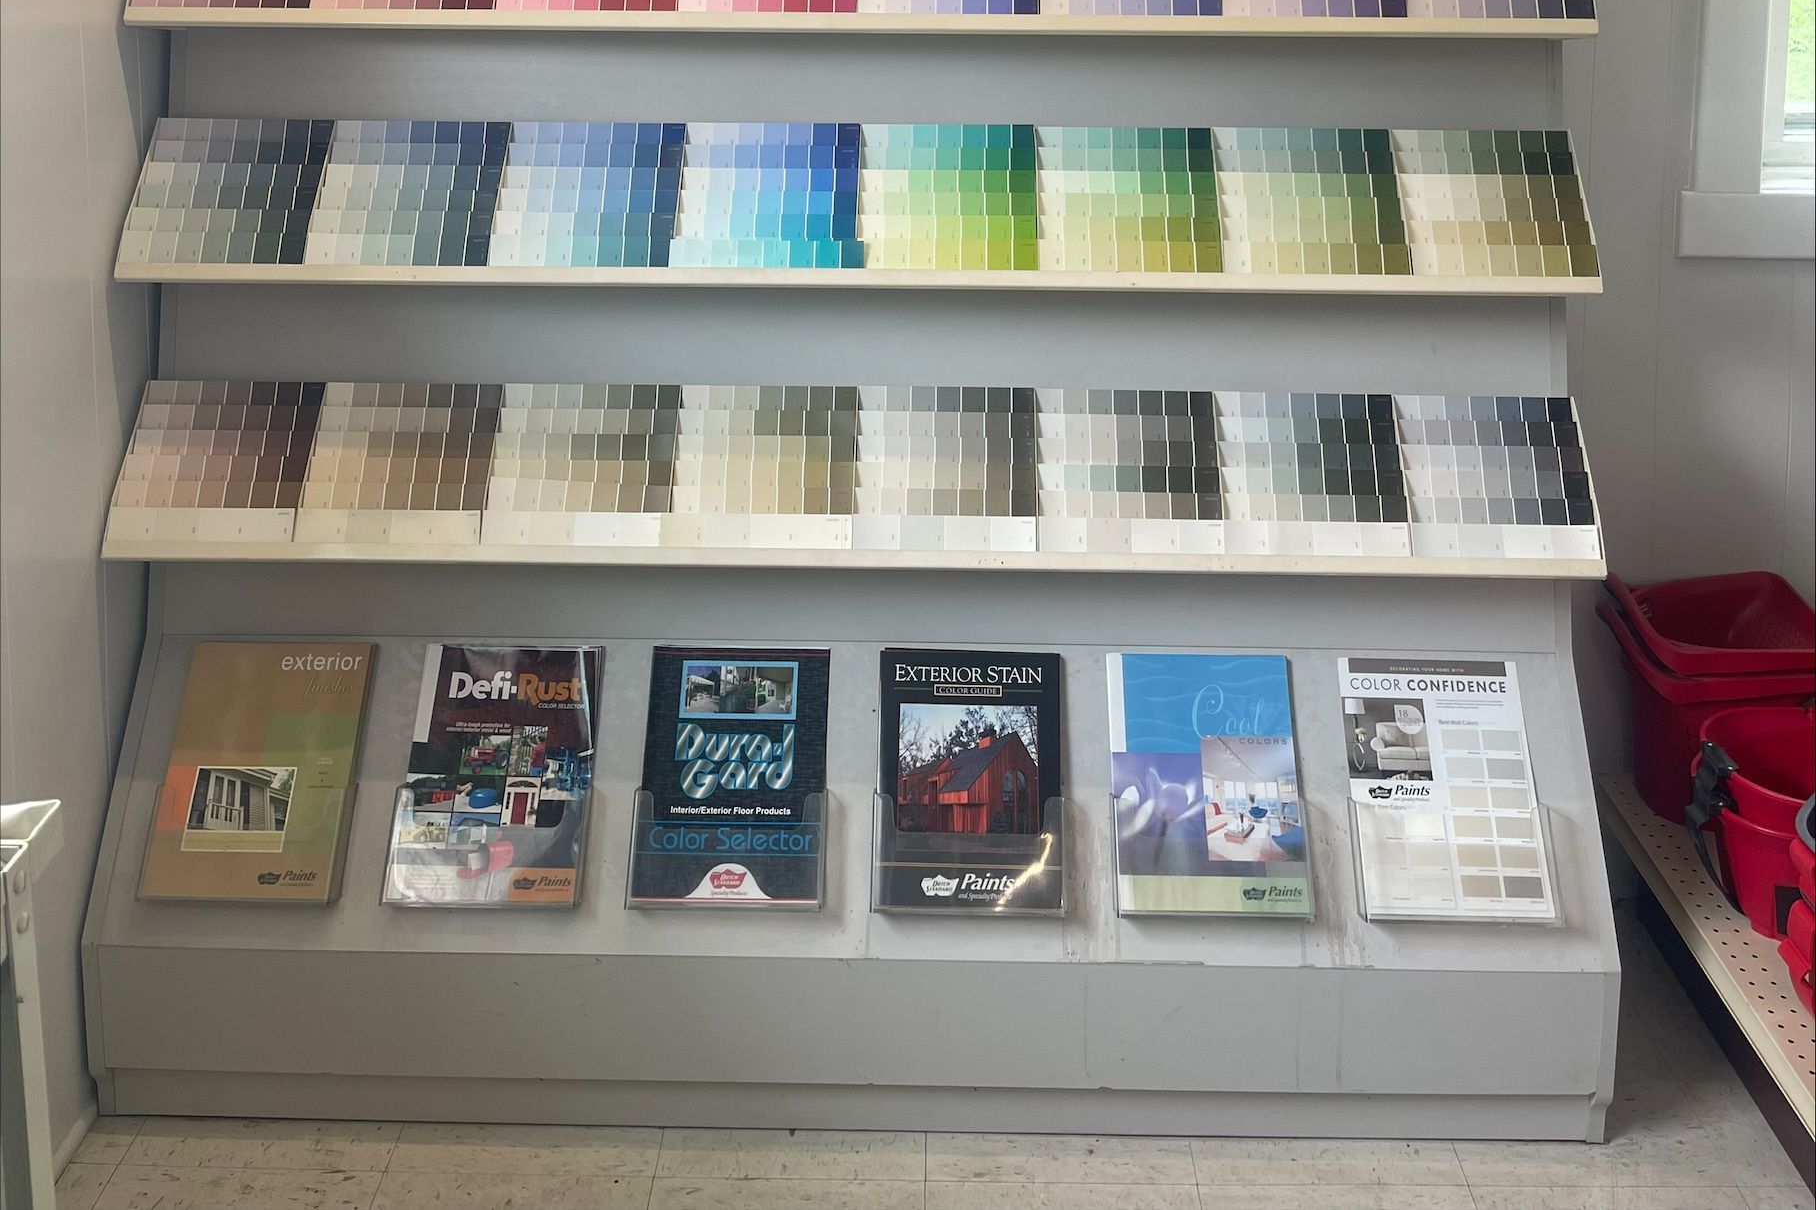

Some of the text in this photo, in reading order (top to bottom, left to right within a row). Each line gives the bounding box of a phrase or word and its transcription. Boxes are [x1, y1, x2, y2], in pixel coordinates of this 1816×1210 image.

[281, 652, 362, 671] exterior
[894, 663, 1043, 684] EXTERIOR STAIN
[448, 671, 581, 706] Defi-Rust
[939, 686, 998, 695] COLOR GUIDE
[1350, 677, 1507, 693] COLOR CONFIDENCE
[1192, 684, 1265, 740] Cool
[1398, 709, 1409, 718] 18
[1239, 737, 1288, 745] COLORS
[680, 723, 795, 800] Gard
[1395, 784, 1431, 796] Paints
[670, 805, 791, 816] Interior/Exterior Floor Products
[648, 826, 813, 851] Color Selector
[283, 869, 318, 881] Paints
[538, 875, 572, 887] Paints
[960, 872, 1016, 890] Paints
[1268, 885, 1303, 897] Paints
